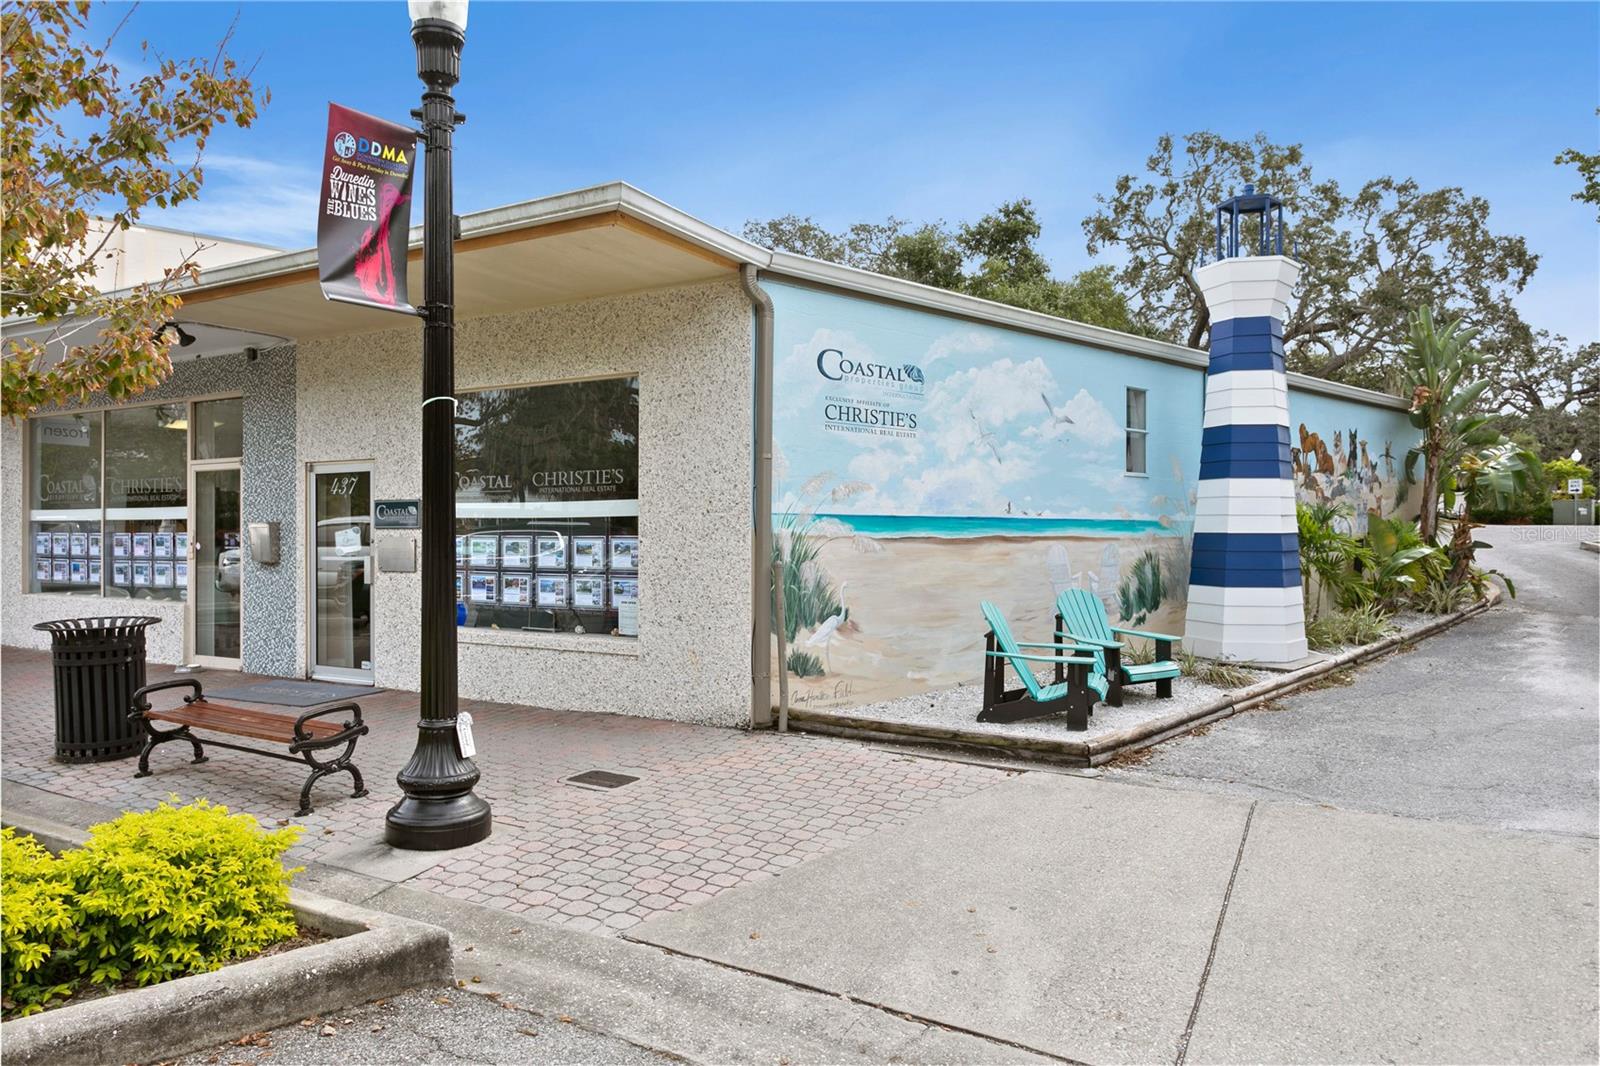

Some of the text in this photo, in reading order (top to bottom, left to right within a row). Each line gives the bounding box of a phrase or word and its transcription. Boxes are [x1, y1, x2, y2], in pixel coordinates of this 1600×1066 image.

[357, 137, 408, 164] DDMA
[330, 165, 375, 188] Dunedin
[329, 179, 376, 206] WINES
[326, 198, 335, 215] THE
[334, 199, 377, 221] BLUES
[817, 348, 906, 382] COASTAL
[825, 403, 918, 429] CHRISTIE'S
[824, 424, 878, 435] INTERNATIONAL
[40, 474, 85, 501] COASTAL
[111, 476, 183, 495] CHRISTIE'S
[330, 475, 359, 495] 437
[456, 472, 513, 489] OASTAL
[532, 468, 624, 487] CHRISTIE'S
